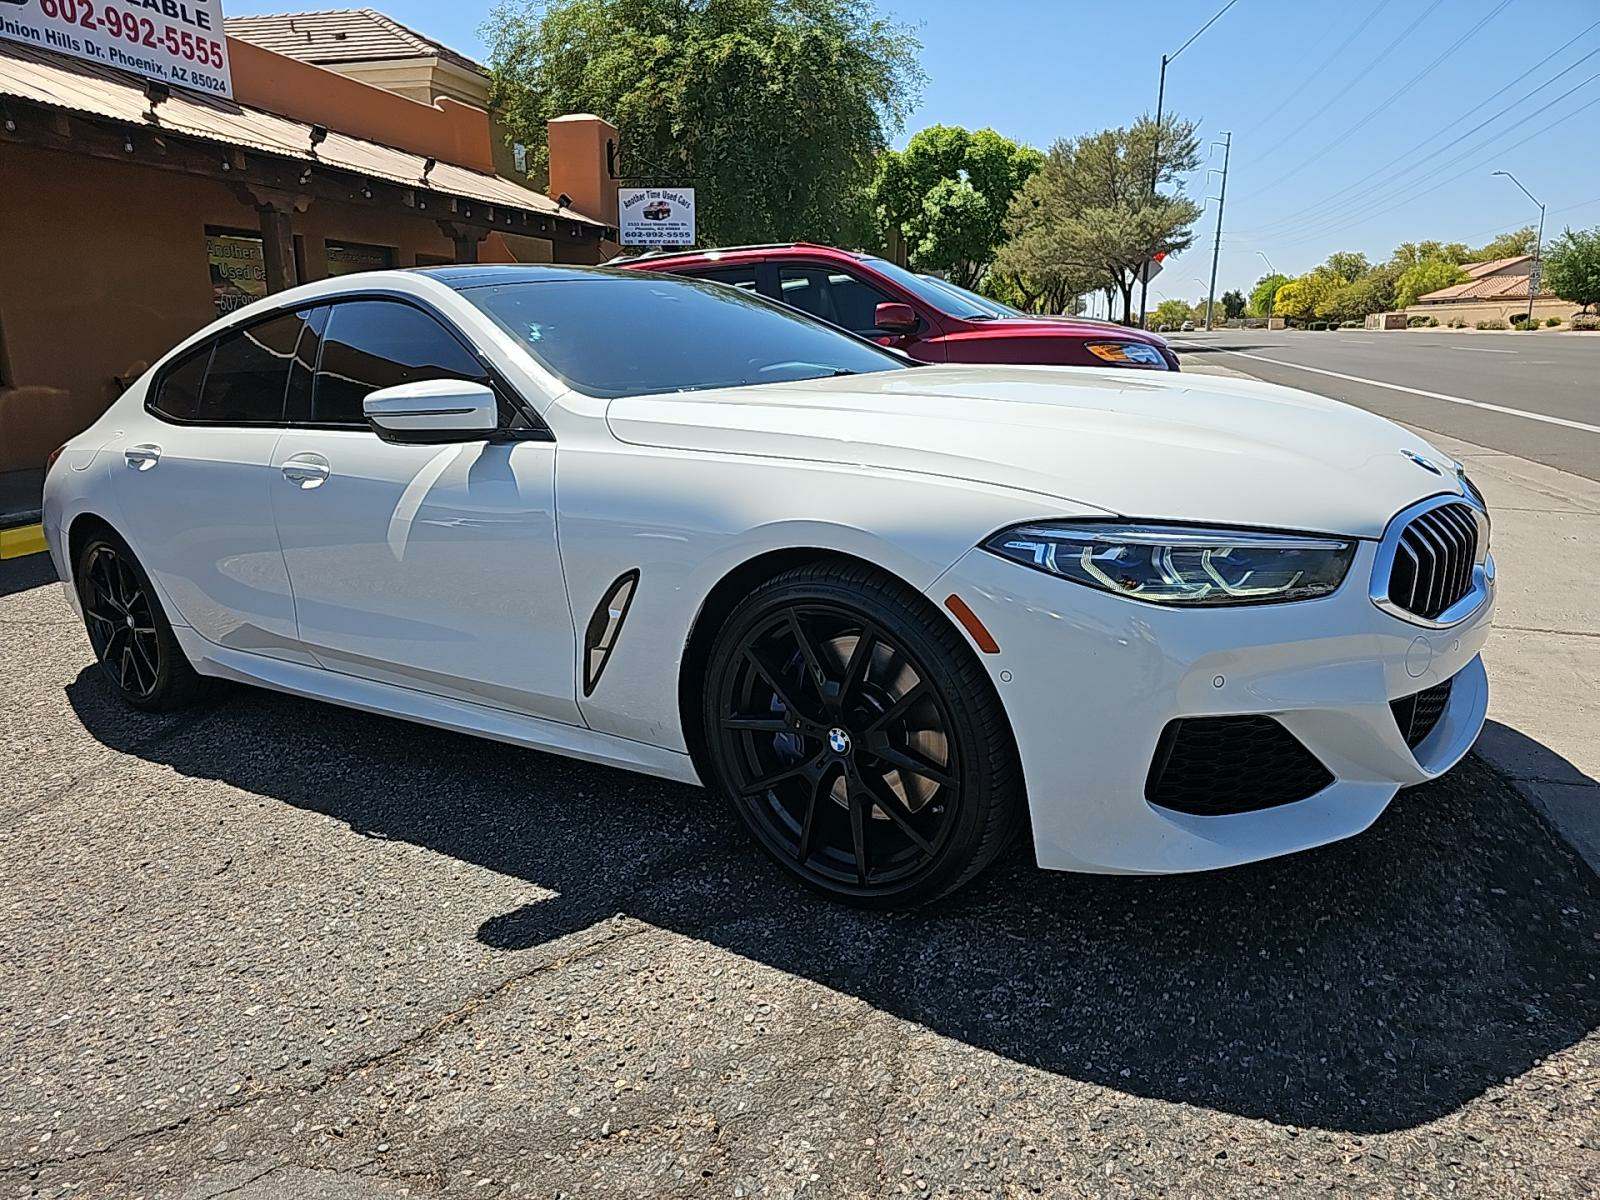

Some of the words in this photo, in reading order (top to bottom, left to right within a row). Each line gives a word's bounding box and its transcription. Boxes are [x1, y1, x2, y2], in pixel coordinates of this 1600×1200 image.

[39, 0, 224, 70] 602-992-5555
[45, 28, 81, 51] Hills
[84, 39, 106, 60] Dr.
[110, 47, 168, 79] Phoenix,
[171, 65, 189, 83] AZ
[191, 71, 227, 94] 85024
[623, 194, 646, 209] Another
[646, 190, 660, 199] Time
[662, 190, 678, 201] Used
[678, 195, 691, 209] Cars
[219, 262, 250, 280] Used
